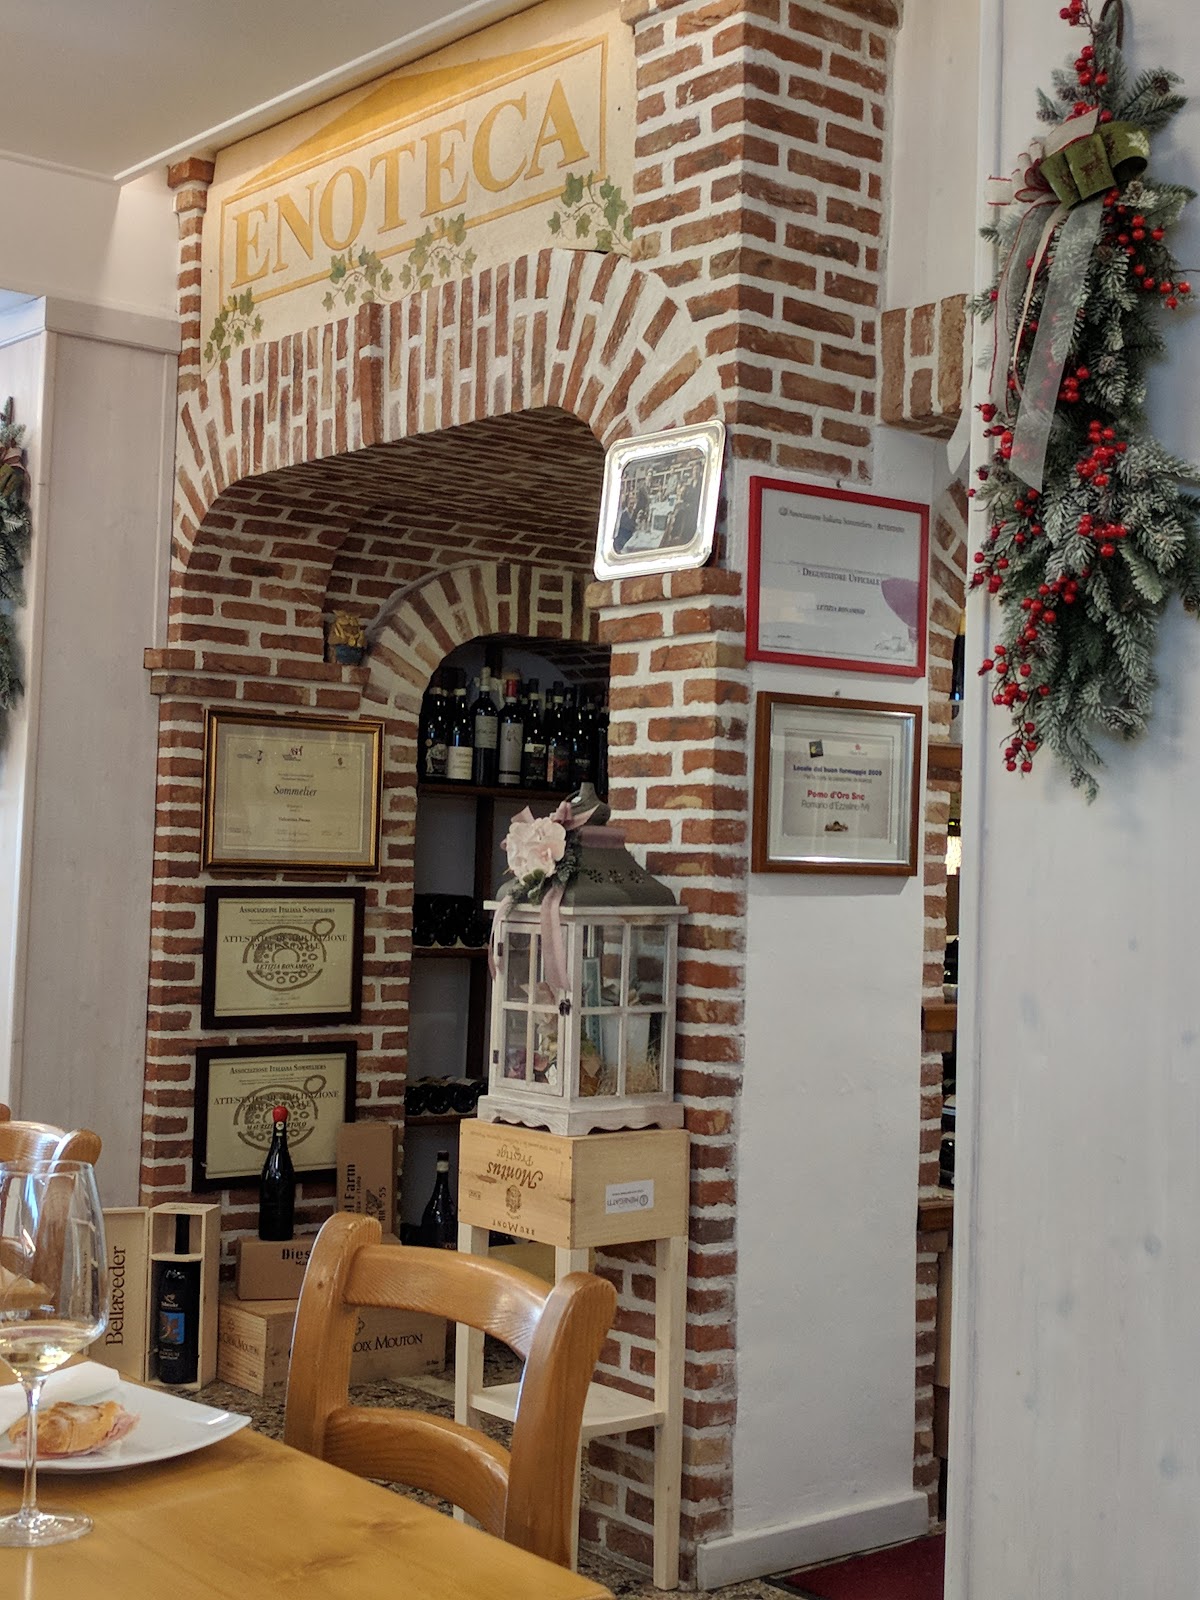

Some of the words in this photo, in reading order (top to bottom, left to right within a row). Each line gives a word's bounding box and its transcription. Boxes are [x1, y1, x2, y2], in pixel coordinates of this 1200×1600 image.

[231, 79, 590, 288] ENOTECA
[273, 785, 318, 797] Sommelier
[807, 790, 828, 799] Pomo
[830, 790, 850, 800] d'Oro
[344, 1164, 356, 1200] Farm
[487, 1161, 544, 1189] Montus
[281, 1248, 311, 1260] Dies
[106, 1246, 126, 1346] Bellaveder
[352, 1340, 372, 1353] OIX
[374, 1333, 424, 1351] MOUTON
